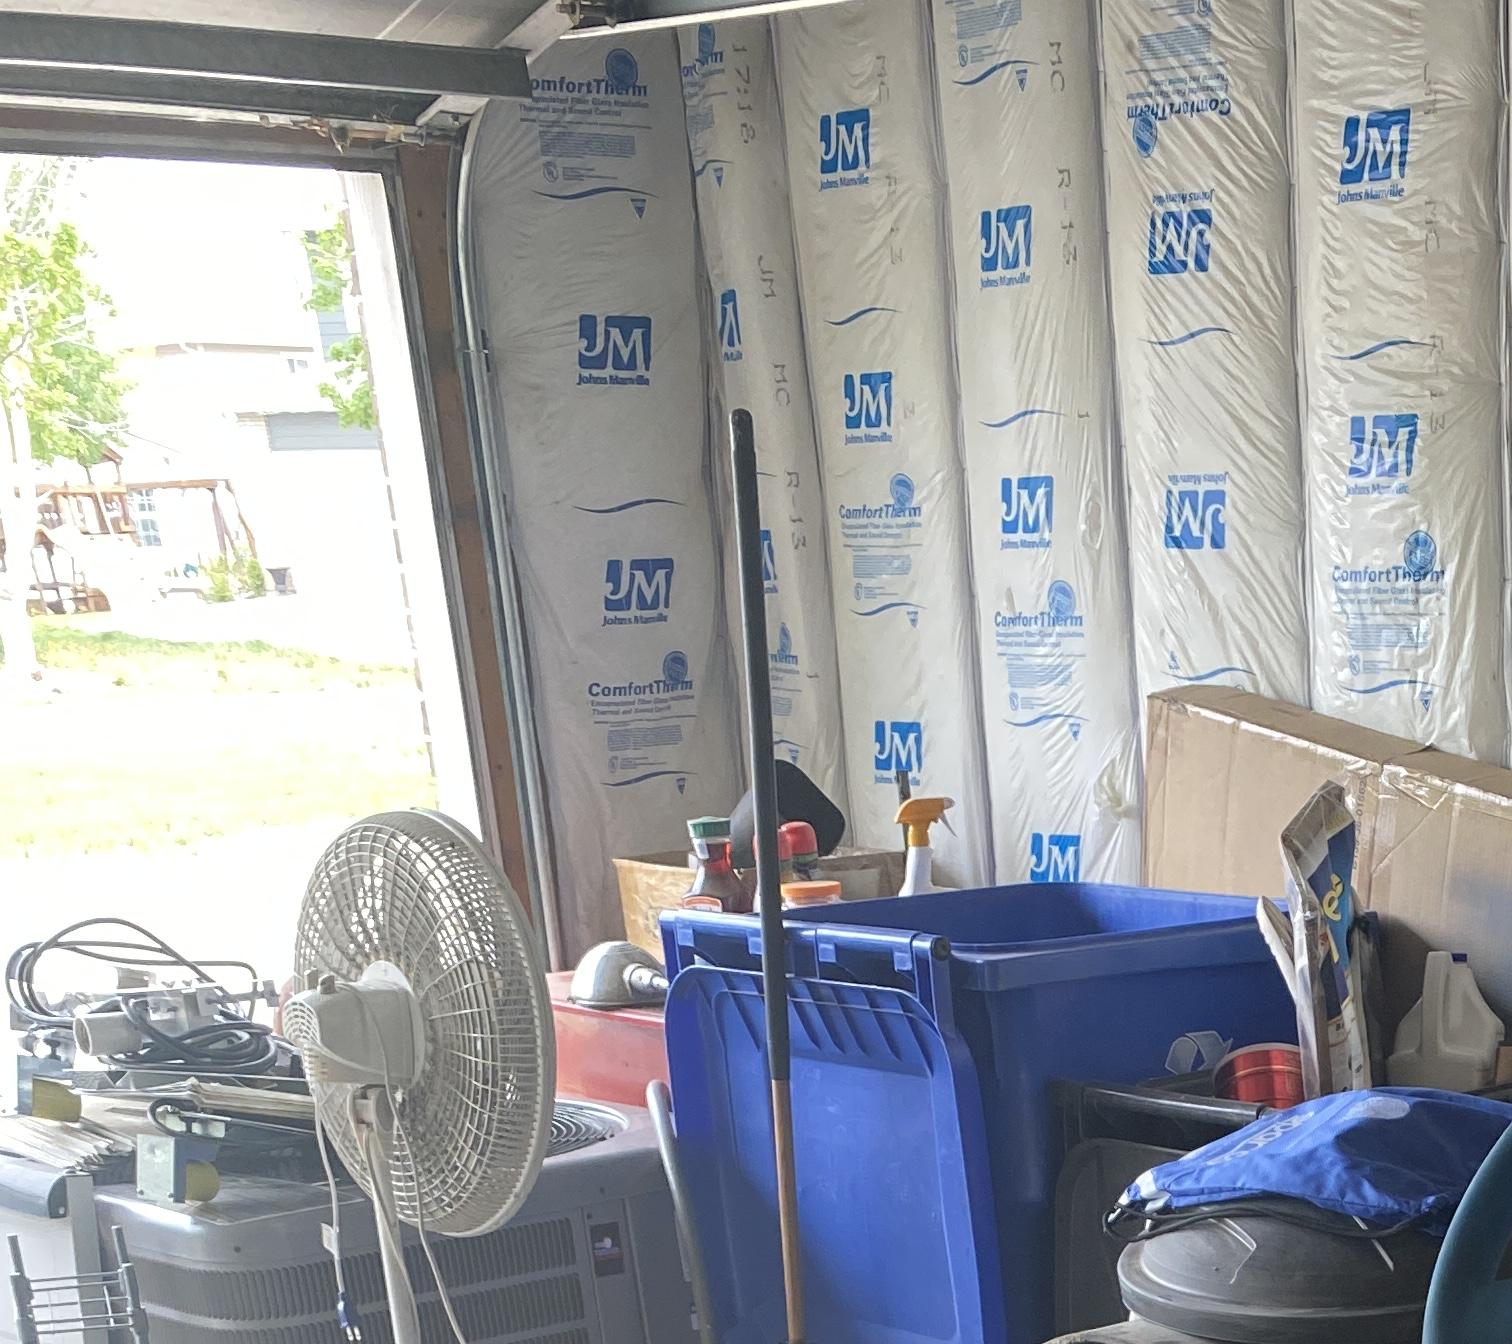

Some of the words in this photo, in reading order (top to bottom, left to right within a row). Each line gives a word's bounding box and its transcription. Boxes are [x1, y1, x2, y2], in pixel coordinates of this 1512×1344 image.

[530, 76, 648, 96] omfortTherm
[820, 108, 870, 174] JM
[1339, 108, 1411, 185] JM
[980, 205, 1032, 272] JM
[579, 314, 651, 371] JM
[844, 371, 893, 429] JM
[1001, 475, 1054, 534] JM
[604, 557, 674, 611] JM
[875, 720, 922, 773] JM
